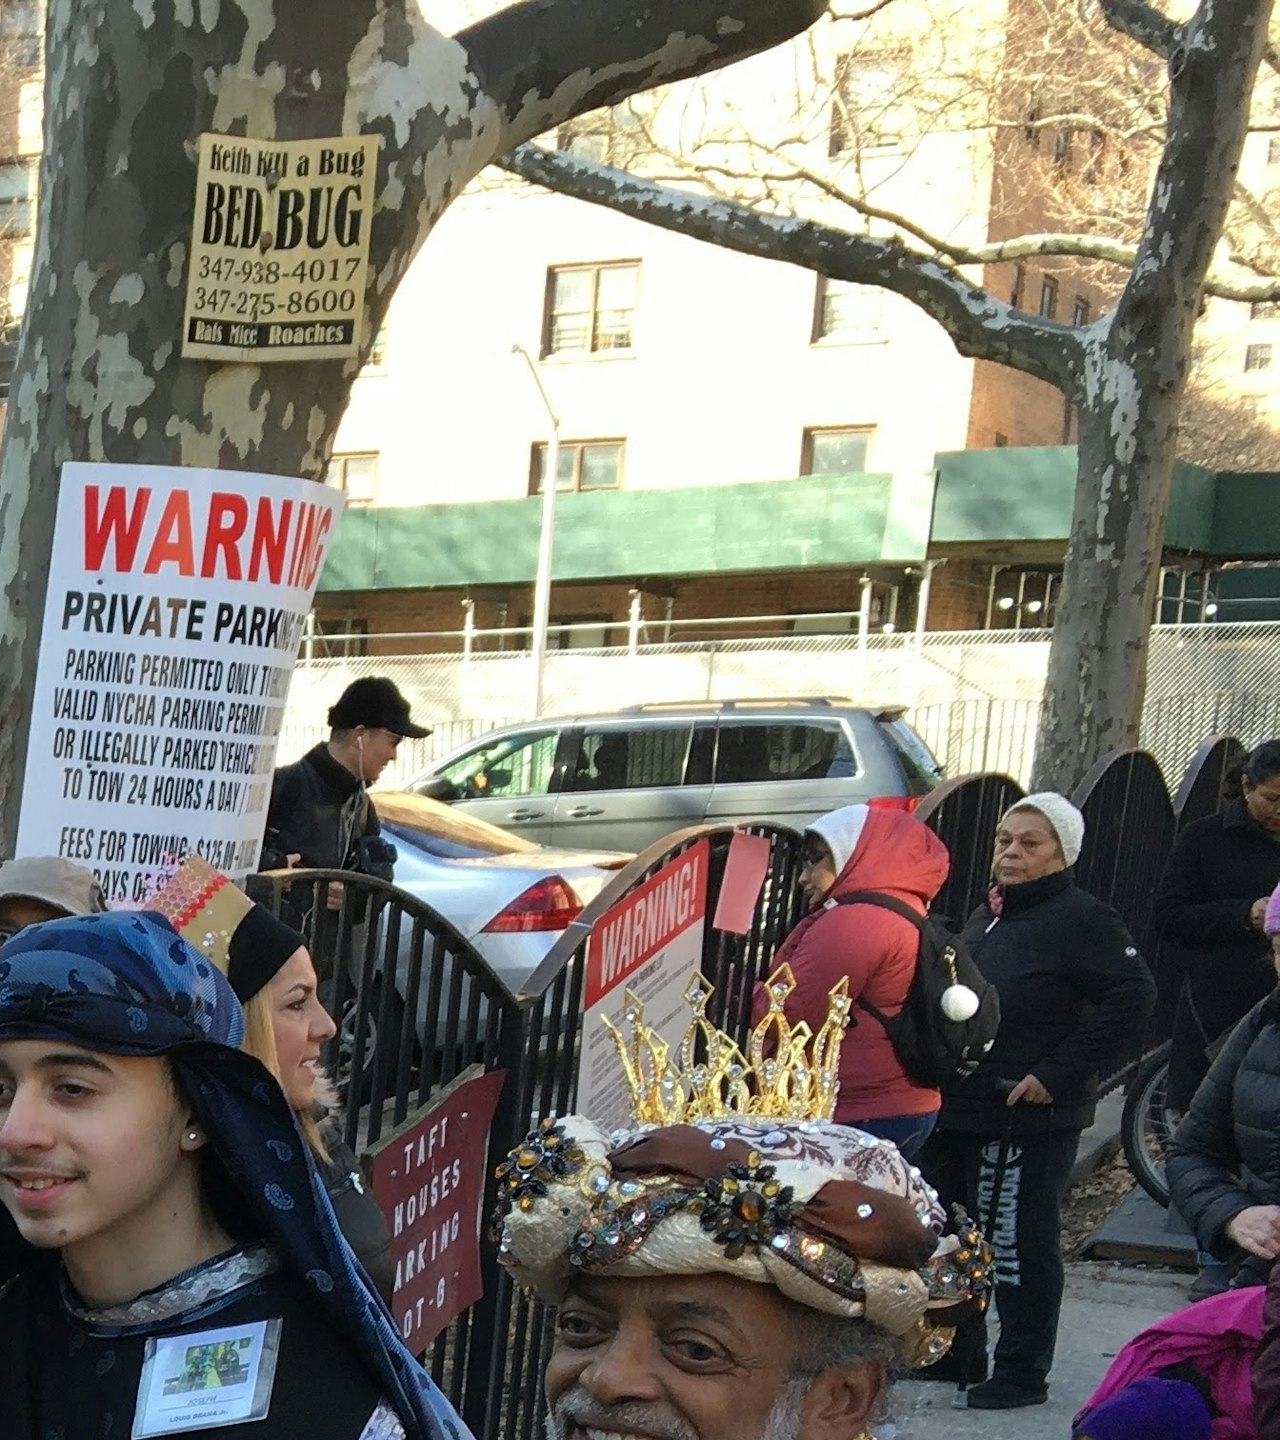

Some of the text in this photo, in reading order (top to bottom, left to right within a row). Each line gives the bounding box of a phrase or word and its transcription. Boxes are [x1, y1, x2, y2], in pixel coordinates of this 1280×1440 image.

[210, 144, 251, 174] Keith
[296, 154, 310, 177] a
[319, 146, 365, 178] Bug
[202, 182, 363, 250] BED BUG
[198, 255, 361, 284] 347-938-4017
[194, 286, 356, 316] 347-275-8600
[195, 321, 345, 345] Rats Mice Roaches
[83, 485, 333, 591] WARNING
[61, 590, 208, 641] PRIVATE
[64, 648, 137, 686] PARKING
[139, 654, 224, 694] PERMITTED
[226, 661, 259, 696] ONLY
[53, 687, 98, 721] VALID
[101, 691, 156, 727] NYCHA
[159, 696, 226, 733] PARKING
[225, 702, 267, 736] PERMI
[52, 727, 272, 775] OR ILLEGALLY PARKED VEHIC
[62, 768, 83, 799] TO
[88, 767, 126, 805] TOW
[127, 773, 147, 806] 24
[151, 775, 204, 811] HOURS
[205, 780, 216, 812] A
[217, 780, 241, 814] DAY
[58, 826, 95, 860] FEES
[96, 829, 128, 862] FOR
[600, 855, 700, 990] WARNING!
[404, 1116, 448, 1175] TAFT
[393, 1158, 461, 1238] HOUSES
[393, 1210, 460, 1293] ARKING
